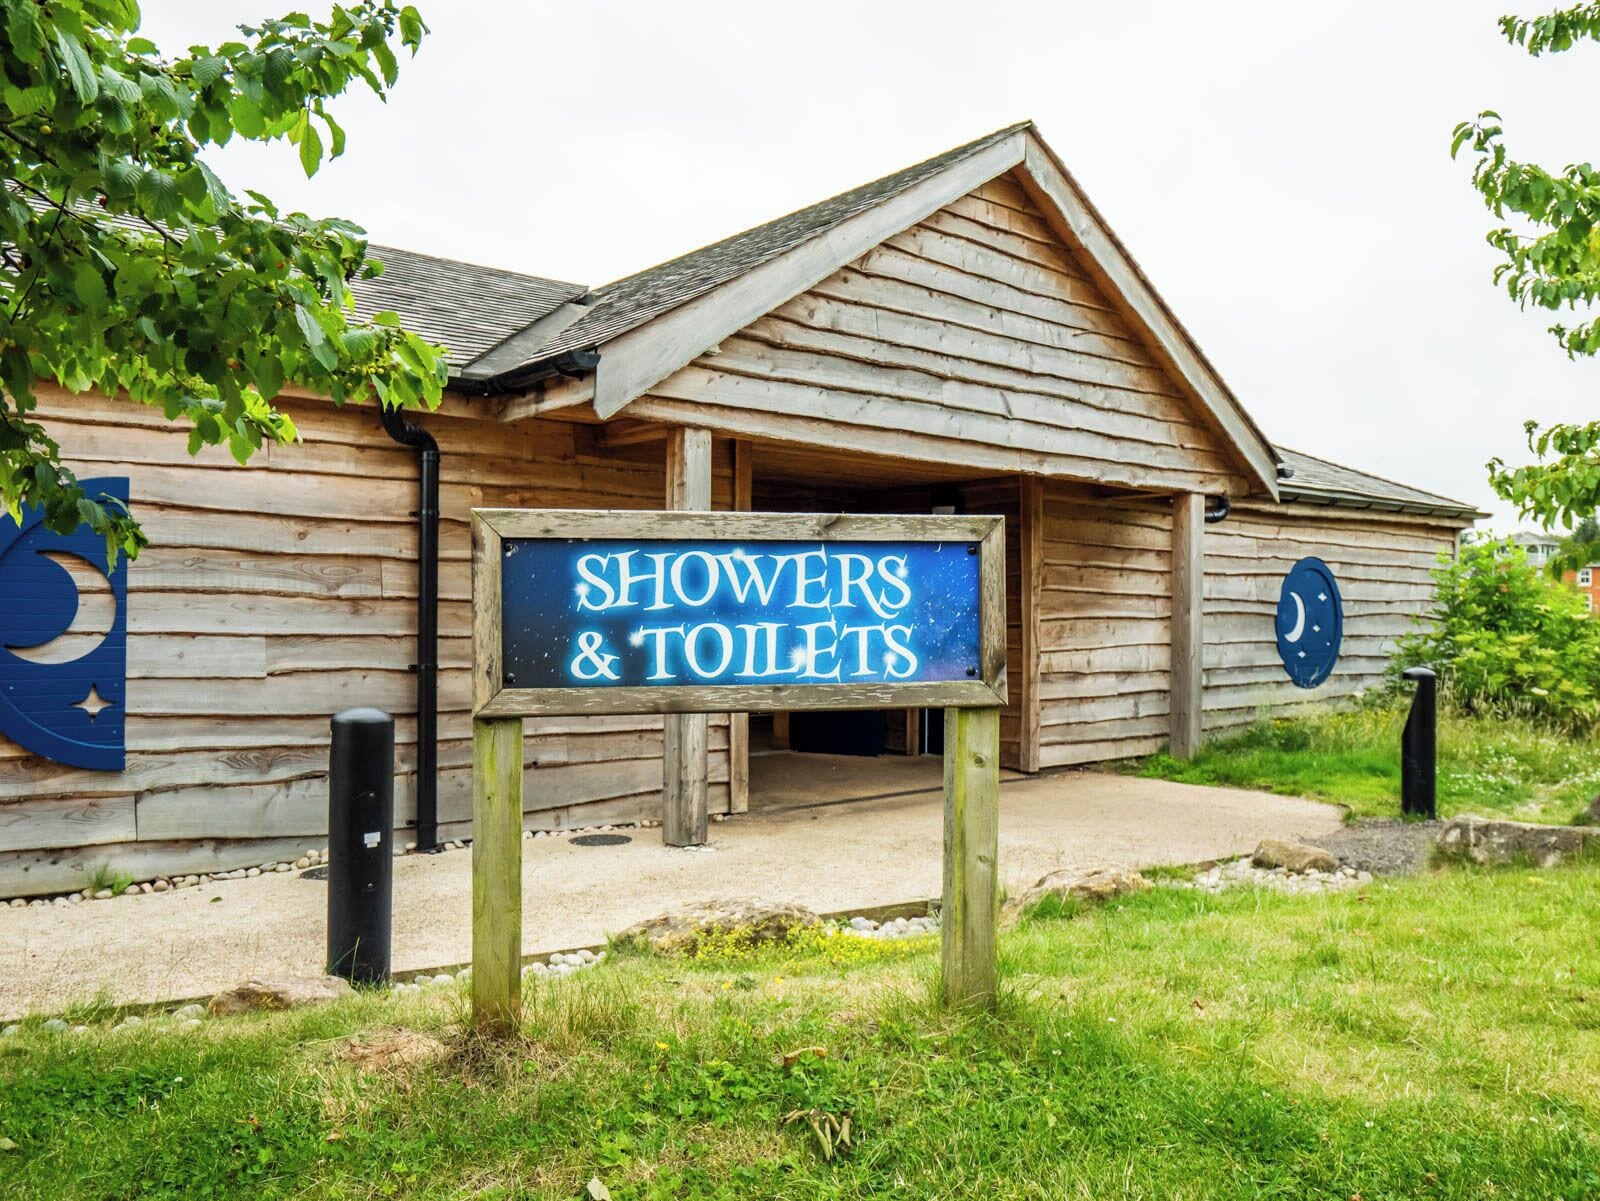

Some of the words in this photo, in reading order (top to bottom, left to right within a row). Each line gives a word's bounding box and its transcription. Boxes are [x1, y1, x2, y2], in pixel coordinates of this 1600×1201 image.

[575, 545, 911, 618] SHOWERS
[570, 631, 620, 680] &
[638, 615, 918, 682] TOILETS
